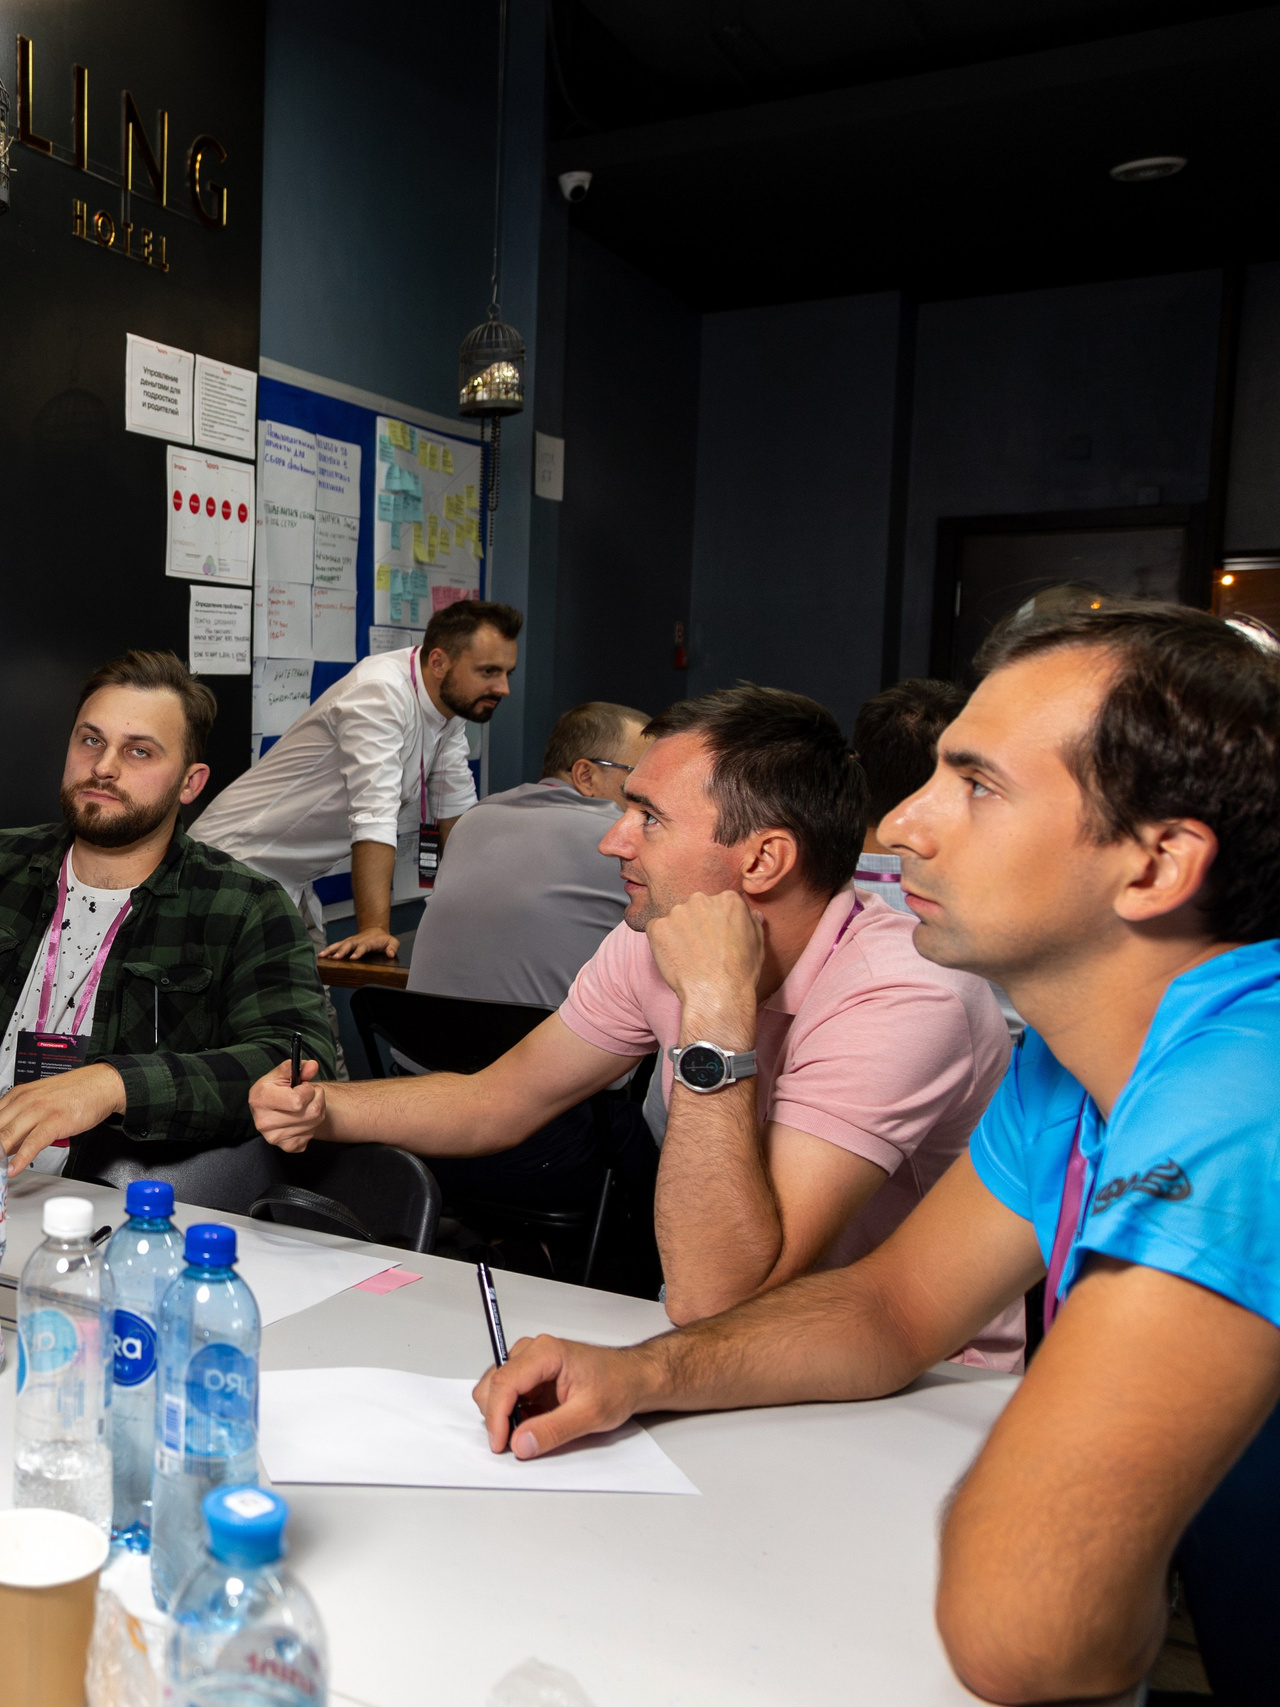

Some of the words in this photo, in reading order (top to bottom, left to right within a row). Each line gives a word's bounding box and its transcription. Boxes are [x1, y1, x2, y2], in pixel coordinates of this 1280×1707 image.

[73, 198, 170, 273] HOTEL
[143, 365, 180, 384] Управление
[140, 378, 169, 392] деньгами
[169, 386, 182, 395] для
[143, 390, 179, 406] подростков
[147, 402, 180, 417] родителей
